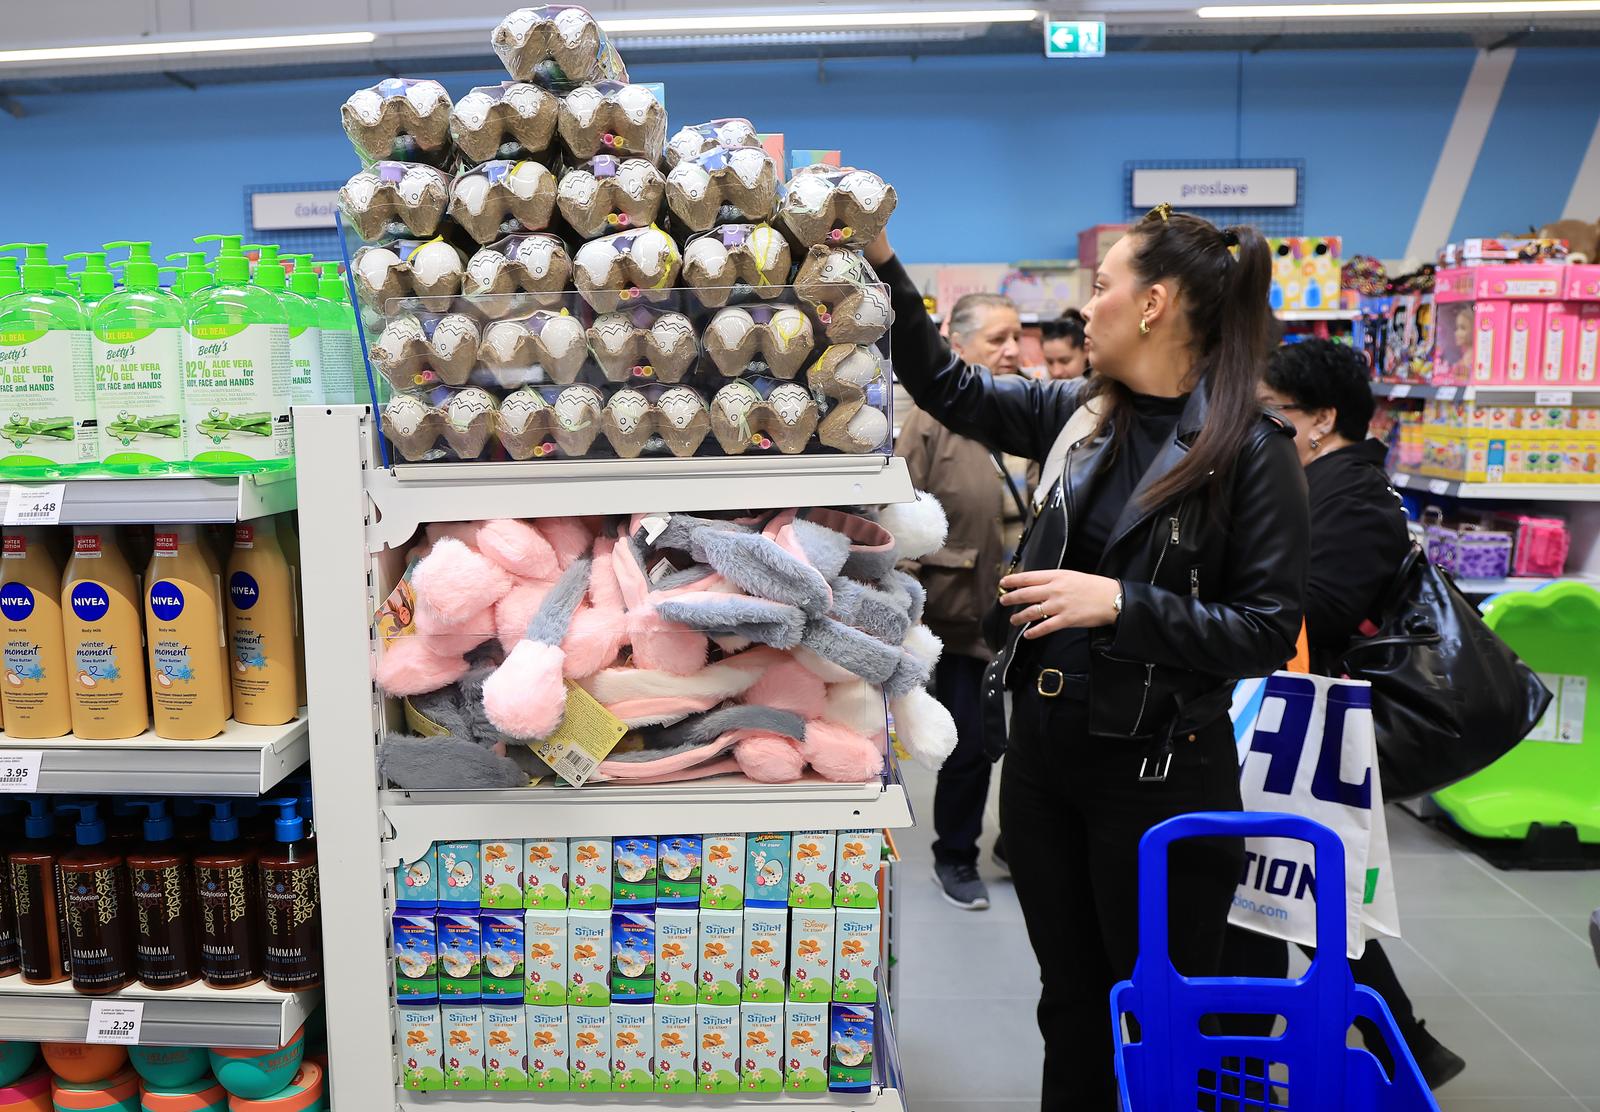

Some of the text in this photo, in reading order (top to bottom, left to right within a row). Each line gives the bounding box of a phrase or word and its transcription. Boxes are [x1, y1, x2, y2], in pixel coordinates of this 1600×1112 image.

[1181, 181, 1249, 198] proslave
[106, 344, 136, 360] Betty's
[198, 340, 228, 356] Betty's
[120, 364, 139, 372] ALOE
[140, 363, 160, 371] VERA
[295, 359, 311, 368] VERA
[12, 366, 30, 374] ALOE
[32, 365, 53, 374] VERA
[185, 359, 253, 379] 92% ALOE VERA
[213, 368, 254, 377] GEL for
[303, 368, 311, 376] for
[13, 374, 54, 383] GEL for
[121, 372, 162, 381] GEL for
[292, 376, 312, 385] HANDS
[107, 382, 121, 390] FACE
[123, 382, 136, 390] and
[137, 381, 162, 390] HANDS
[199, 379, 213, 387] FACE
[215, 379, 228, 387] and
[229, 378, 255, 386] HANDS
[0, 383, 55, 392] FACE and HANDS
[231, 586, 256, 595] NIVEA
[1, 597, 31, 606] NIVEA
[74, 597, 106, 606] NIVEA
[152, 597, 181, 606] NIVEA
[4, 644, 42, 656] moment
[76, 644, 117, 656] moment
[154, 644, 192, 656] moment
[6, 768, 29, 778] 3.95
[69, 894, 100, 902] Bodylotion
[134, 890, 162, 899] Bodylotion
[200, 890, 228, 899] Bodylotion
[267, 892, 296, 900] Bodylotion
[73, 948, 108, 959] HAMMAM
[138, 944, 170, 955] HAMMAM
[203, 944, 235, 955] HAMMAM
[267, 946, 302, 957] HAMMAM
[113, 1020, 135, 1030] 2.29
